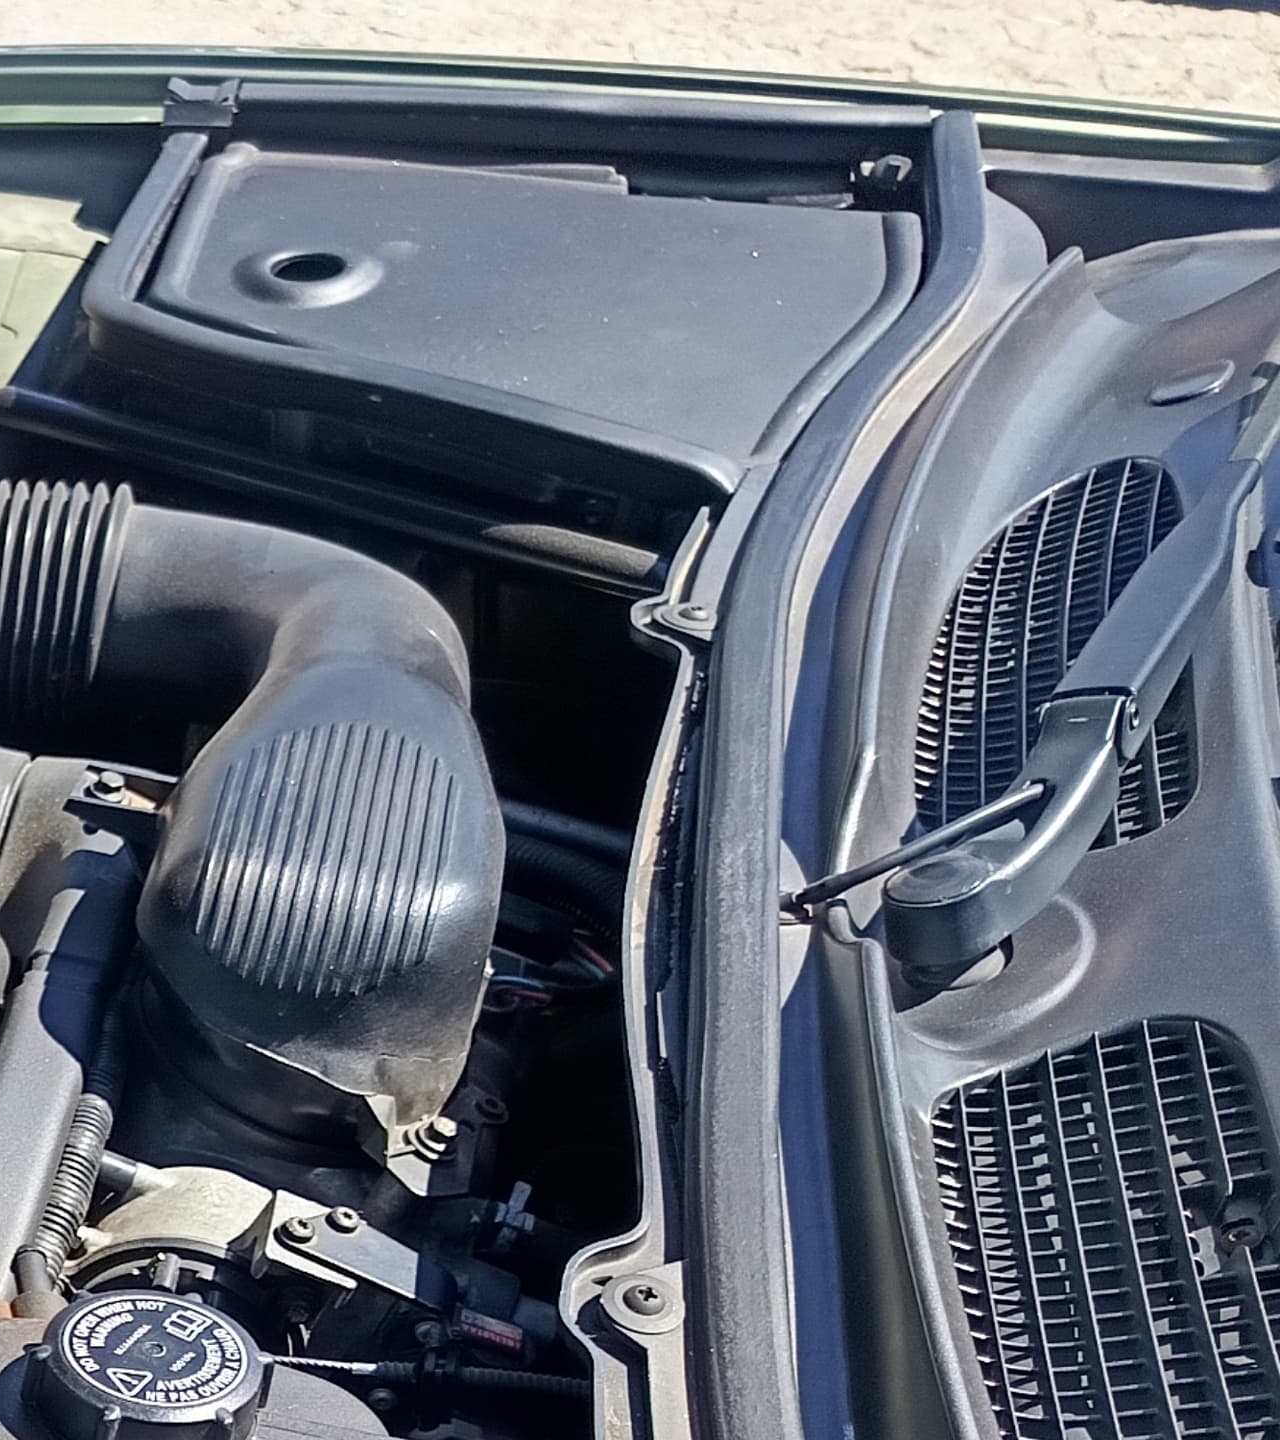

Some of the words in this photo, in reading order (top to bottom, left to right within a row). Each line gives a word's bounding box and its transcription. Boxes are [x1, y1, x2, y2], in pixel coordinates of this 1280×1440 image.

[96, 1300, 135, 1318] WHEN
[135, 1300, 168, 1312] HOT
[73, 1312, 101, 1337] OPEN
[90, 1312, 134, 1348] WARNING
[71, 1337, 90, 1358] NOT
[79, 1357, 100, 1372] DO
[145, 1390, 167, 1402] NE
[169, 1391, 200, 1403] PAS
